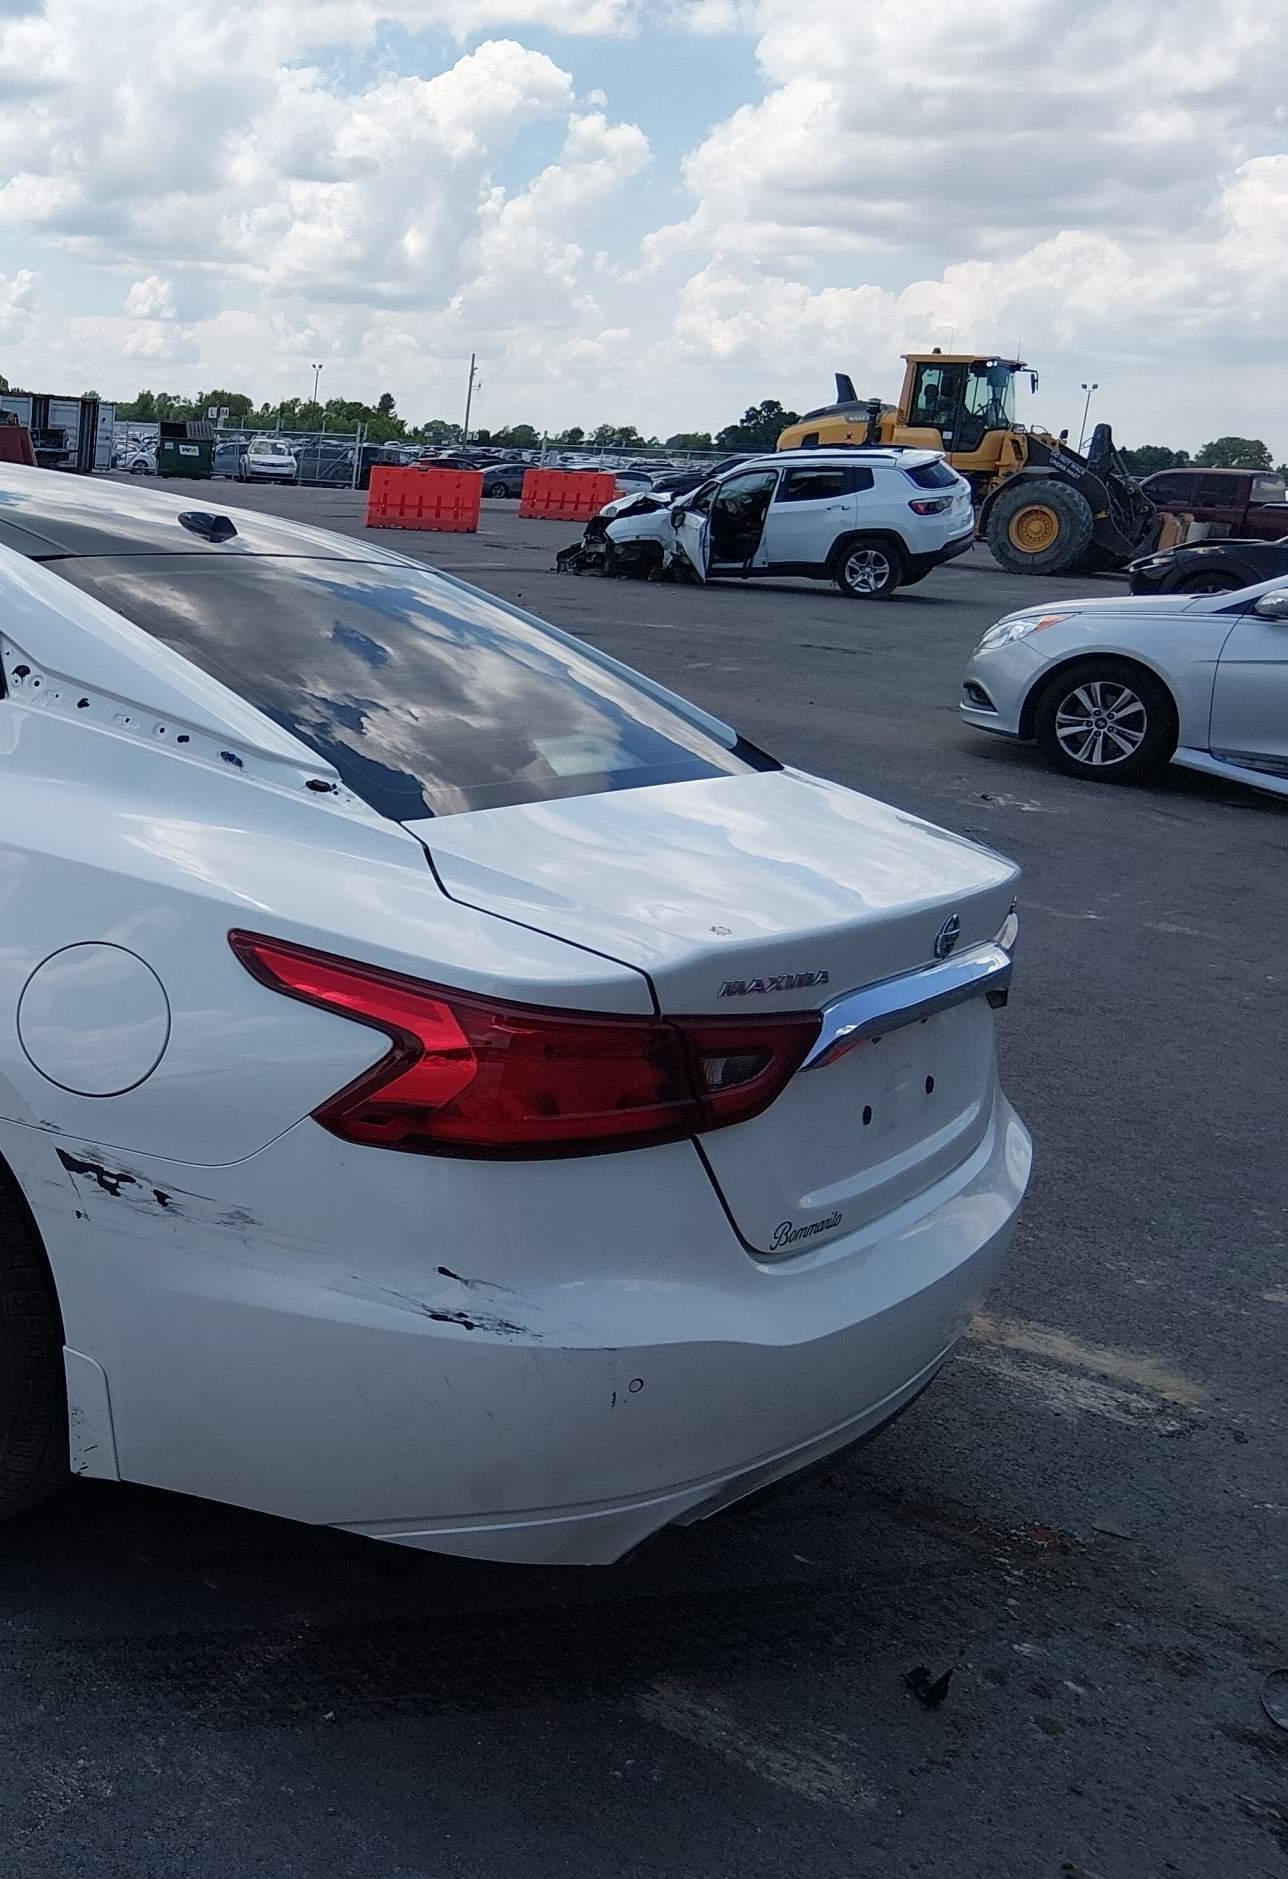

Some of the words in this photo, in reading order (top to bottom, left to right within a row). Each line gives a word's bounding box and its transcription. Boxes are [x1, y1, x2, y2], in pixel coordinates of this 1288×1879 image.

[1059, 454, 1072, 465] NOT
[717, 969, 829, 998] MAXIMA
[769, 1211, 842, 1251] Bommarito
